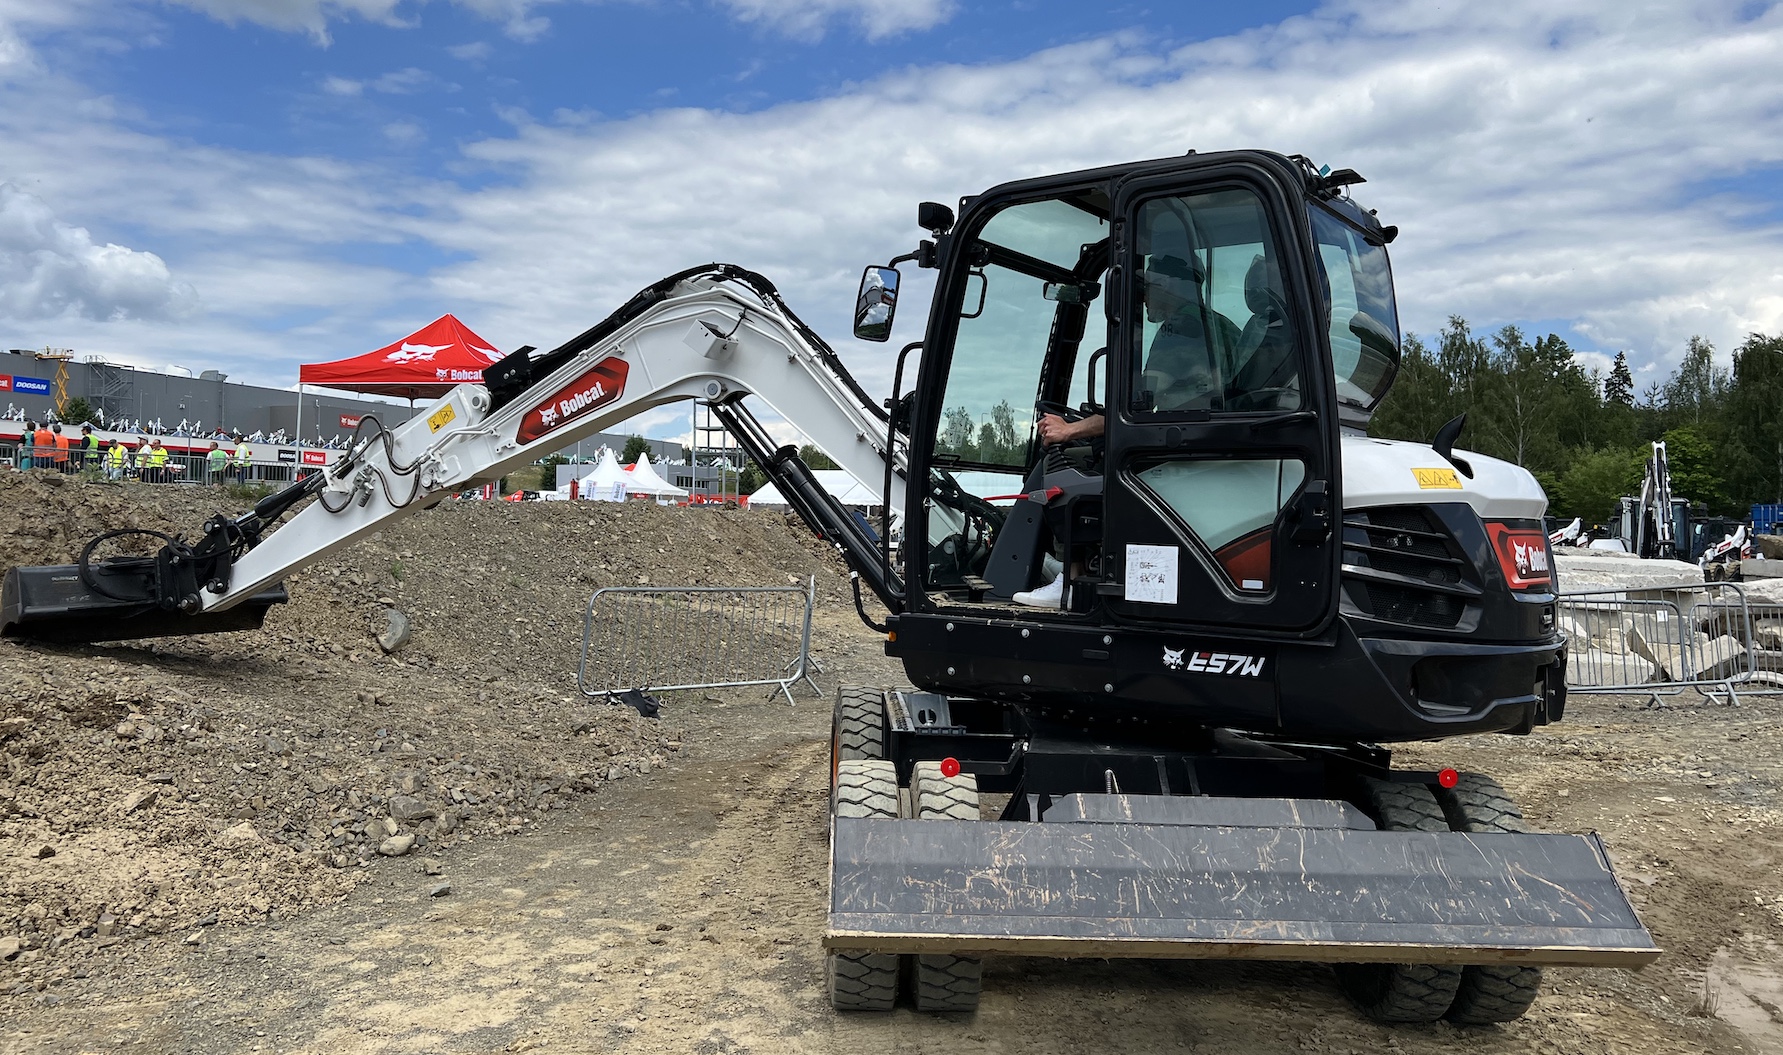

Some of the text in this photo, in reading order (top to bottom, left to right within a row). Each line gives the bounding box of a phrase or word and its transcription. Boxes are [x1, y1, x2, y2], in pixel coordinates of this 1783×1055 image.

[451, 369, 483, 380] Bobcat
[16, 381, 47, 390] DOOSAN
[559, 381, 605, 417] Bobcat
